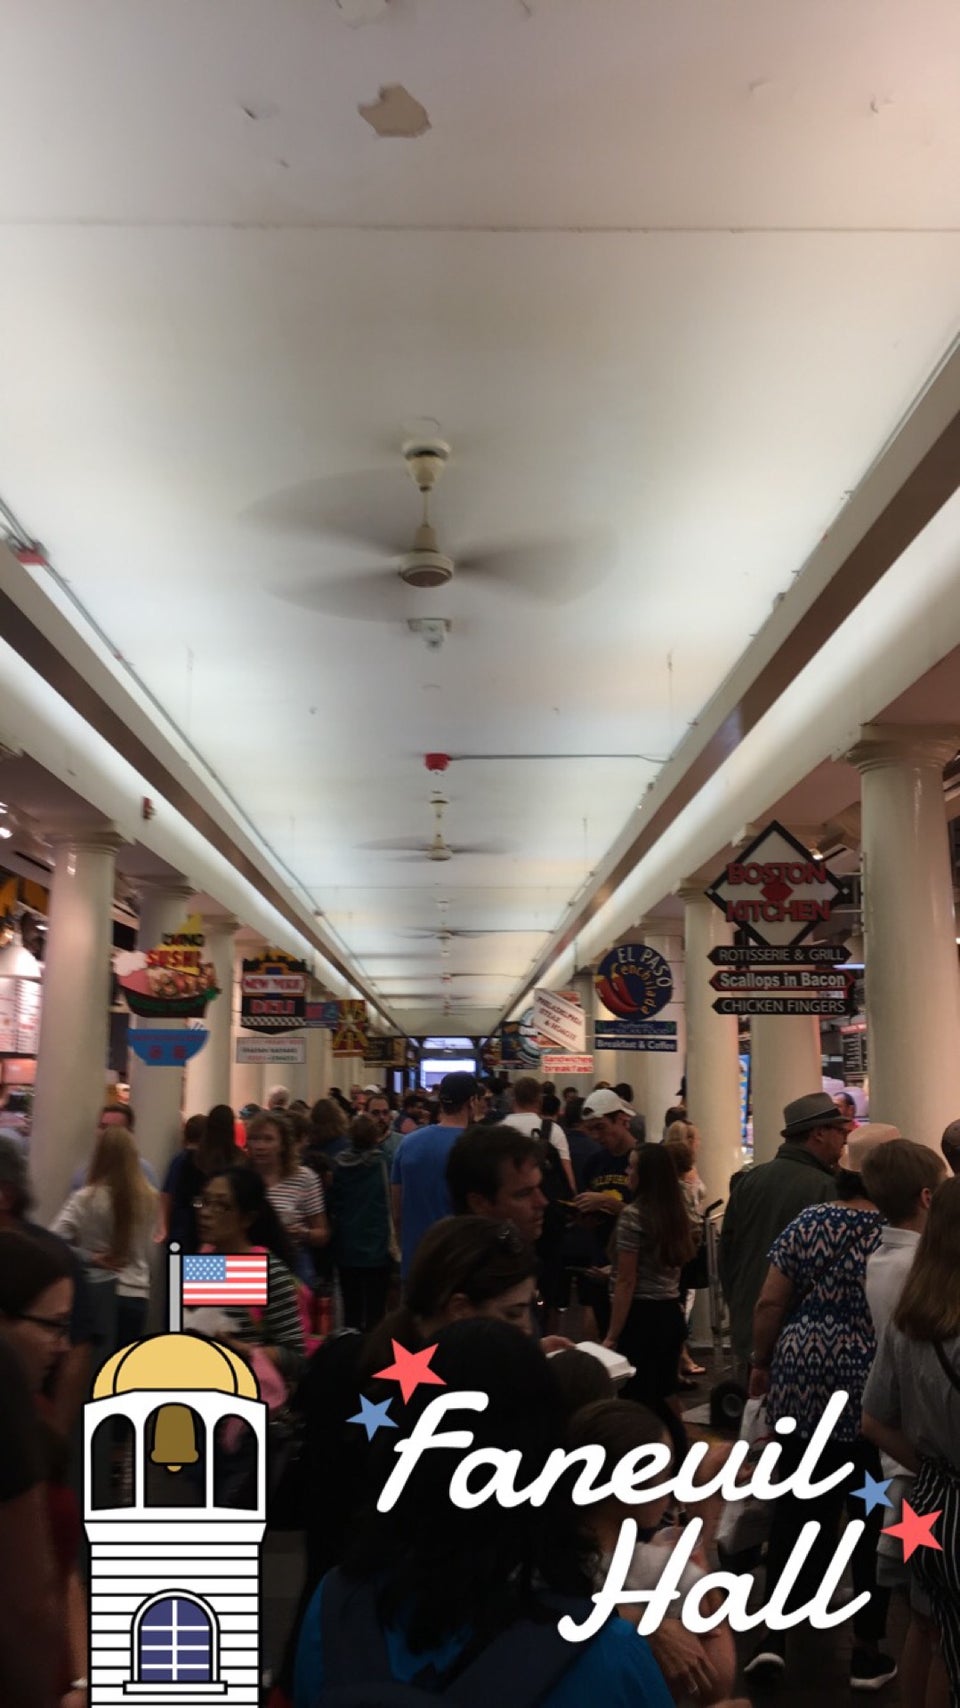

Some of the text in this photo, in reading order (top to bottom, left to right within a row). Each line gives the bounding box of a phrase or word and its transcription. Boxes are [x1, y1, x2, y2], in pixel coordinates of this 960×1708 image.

[726, 862, 827, 885] BOSTON
[725, 900, 831, 923] KITCHEN
[719, 949, 844, 961] ROTISSERIE & GRILL
[617, 947, 673, 987] EL PASO
[720, 973, 846, 990] Scallops in Bacon
[251, 1000, 295, 1015] DELI
[721, 1000, 846, 1013] CHICKEN FINGERS
